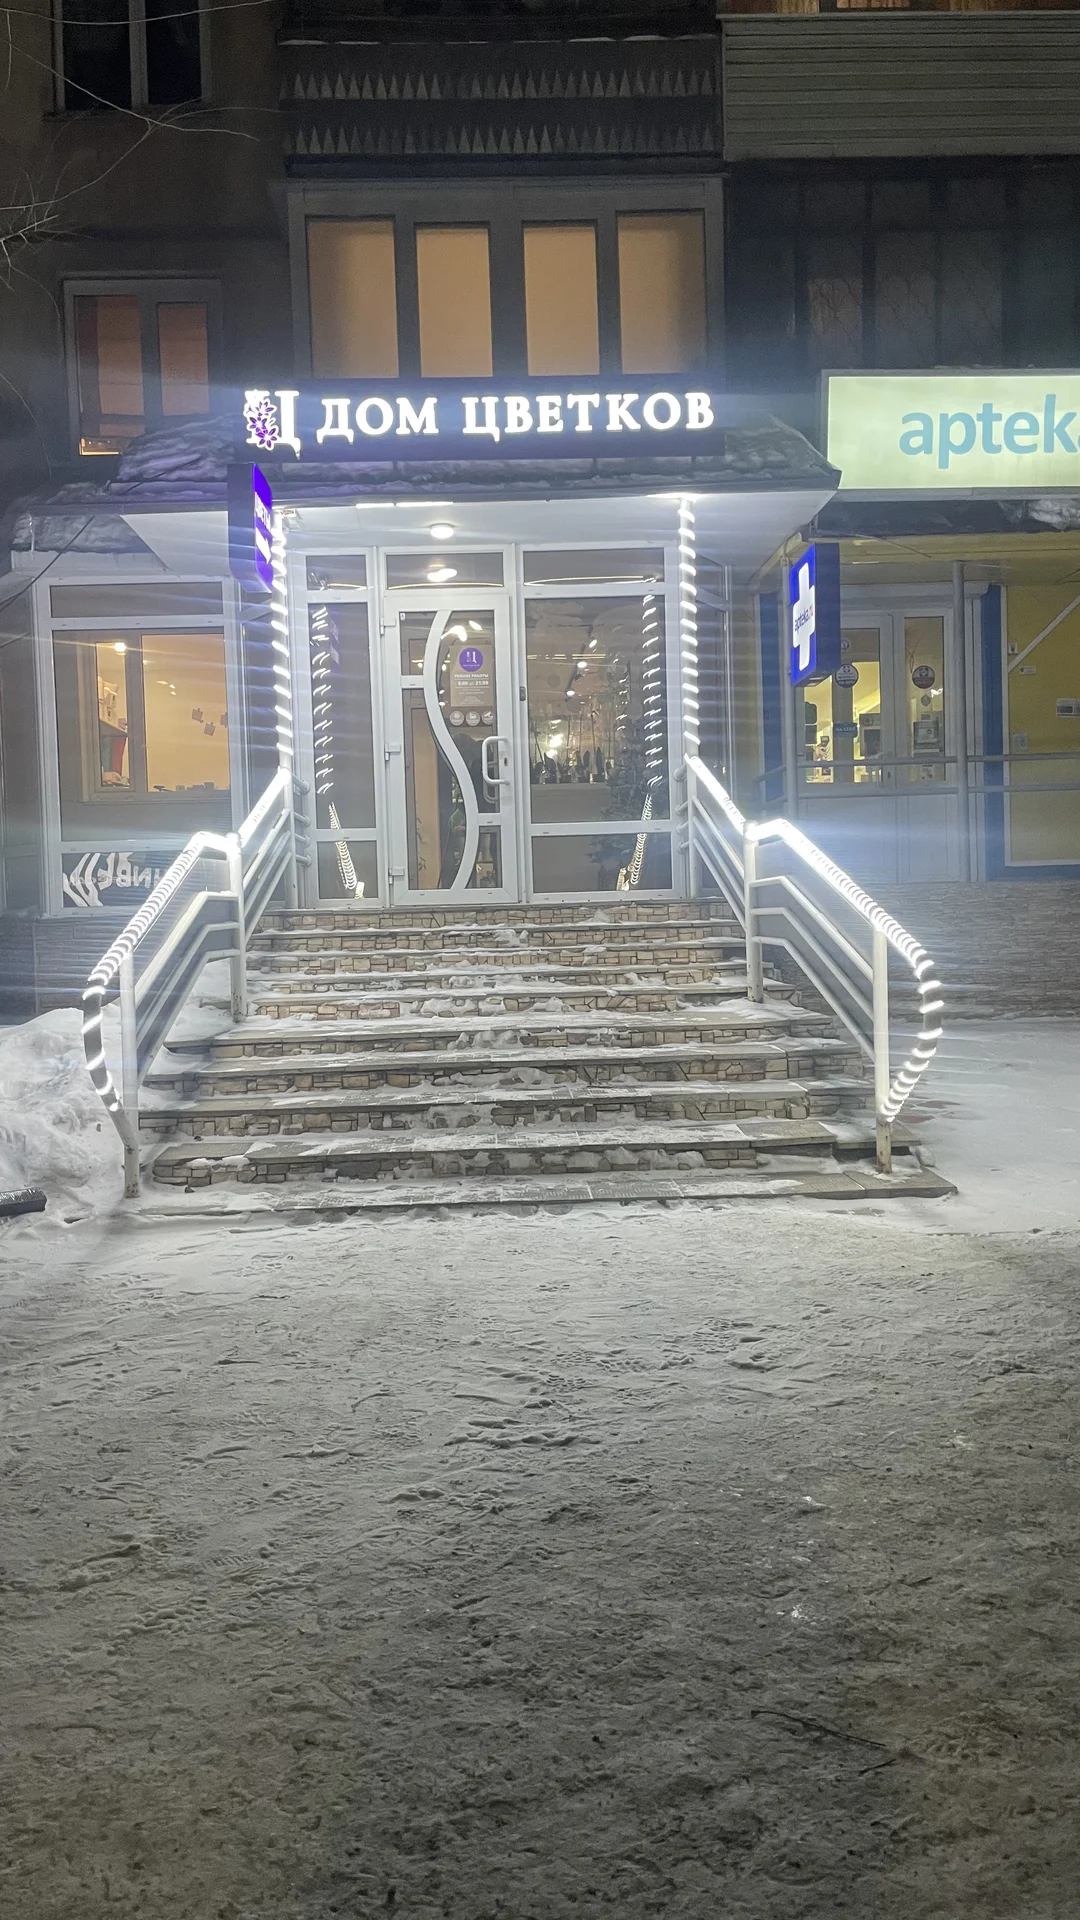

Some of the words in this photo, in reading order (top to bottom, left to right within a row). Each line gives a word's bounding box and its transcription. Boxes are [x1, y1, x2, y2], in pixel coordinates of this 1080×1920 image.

[316, 396, 439, 444] ДОМ
[462, 391, 715, 443] ЦВЕТКОВ
[899, 394, 1080, 469] aptek
